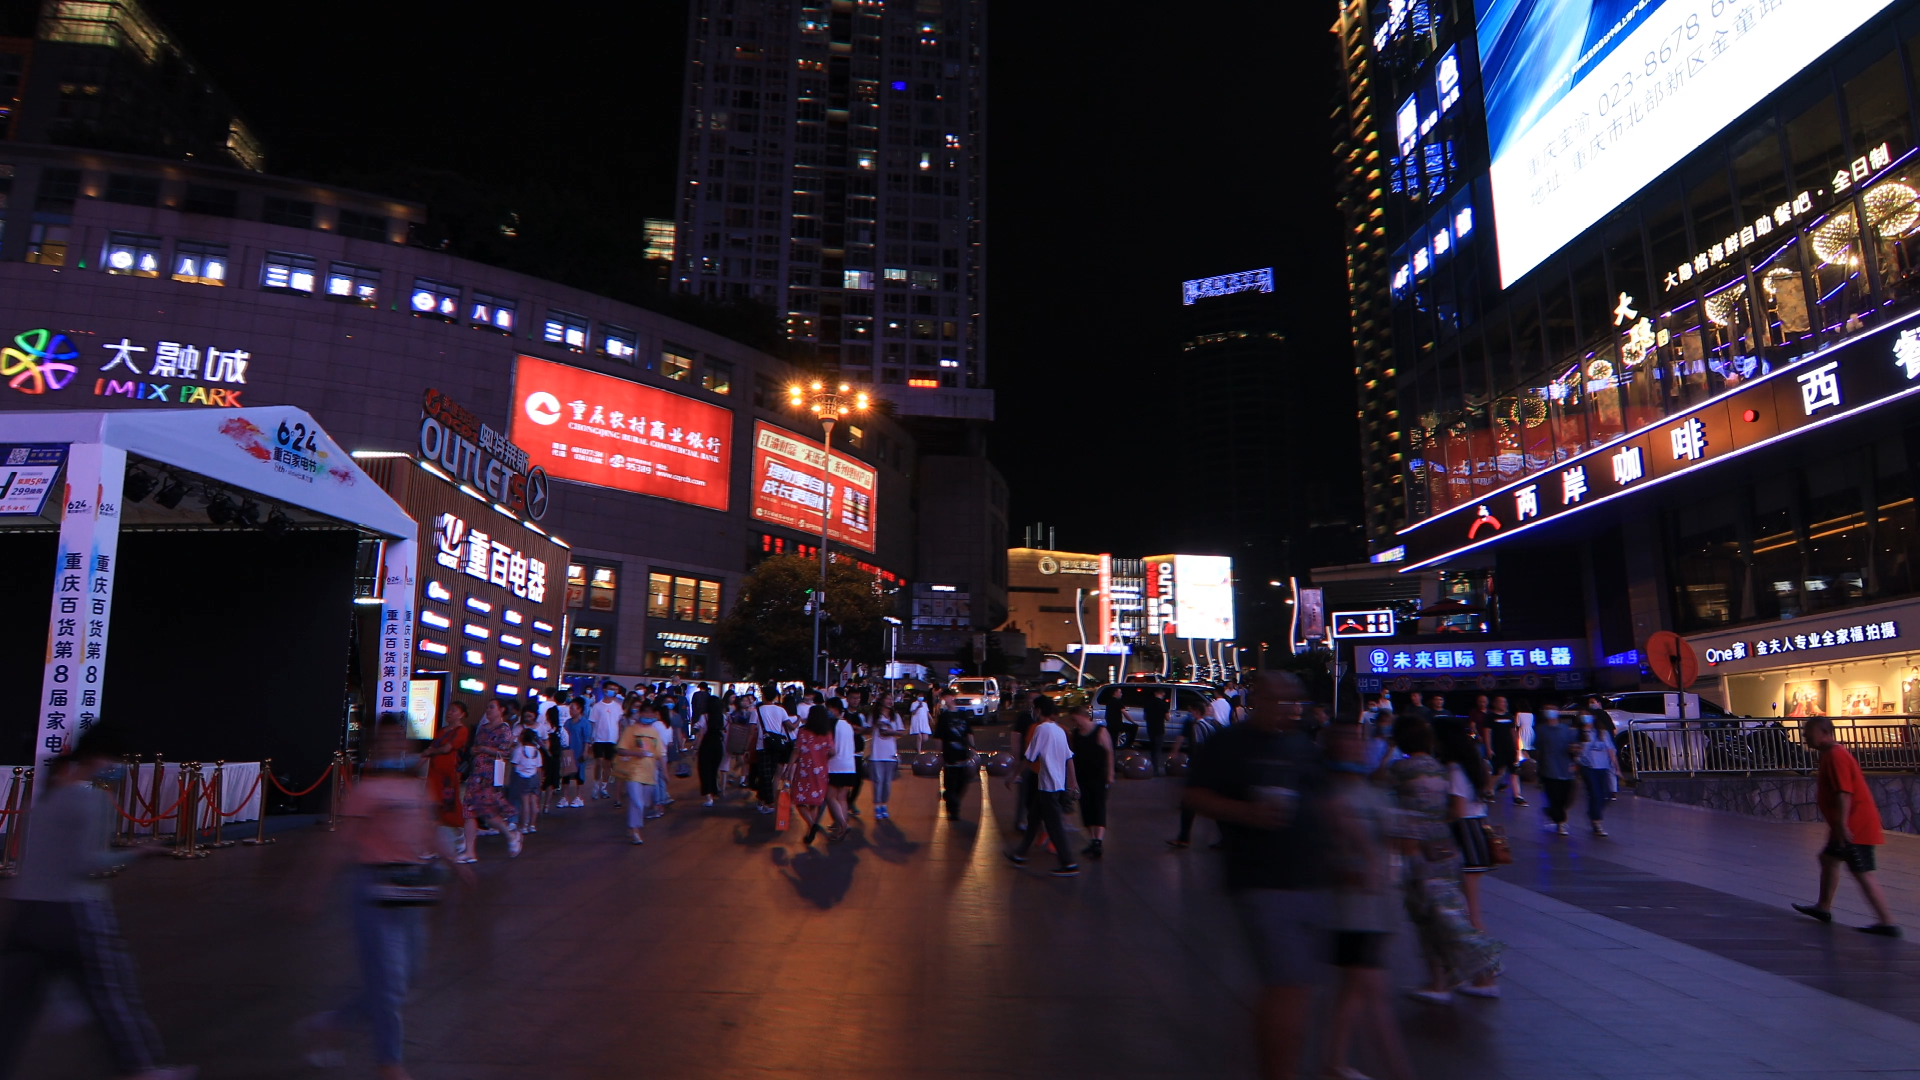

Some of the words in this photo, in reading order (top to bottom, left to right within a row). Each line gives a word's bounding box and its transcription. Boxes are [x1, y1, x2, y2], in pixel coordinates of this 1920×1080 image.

[1598, 13, 1700, 118] 023-8678
[99, 338, 251, 384] 大融城
[94, 378, 172, 402] IMIX
[179, 384, 243, 408] PARK
[567, 400, 722, 454] 重庆农村商业银行
[568, 422, 621, 439] CHONGQING
[622, 434, 649, 446] RURAL
[649, 440, 700, 459] COMMERCIAL
[701, 453, 720, 463] BANK
[273, 446, 317, 473] 重百家电节
[421, 417, 527, 511] OUTLETS
[479, 423, 530, 477] 奥特莱斯
[625, 463, 652, 474] 95389
[1514, 417, 1706, 522] 两岸咖啡
[67, 500, 87, 510] 624
[100, 503, 114, 512] 624
[466, 528, 546, 603] 重百电器
[656, 632, 710, 644] STARBUCKS
[663, 640, 698, 650] COFFEE
[1393, 649, 1475, 670] 未来国际
[1485, 646, 1571, 668] 重百电器
[1706, 641, 1747, 663] One家
[1756, 620, 1899, 656] 金夫人专业全家福拍摄
[44, 552, 84, 767] 重庆百货第8届家电
[380, 609, 399, 719] 重庆百货第8届
[1358, 677, 1379, 687] 出口
